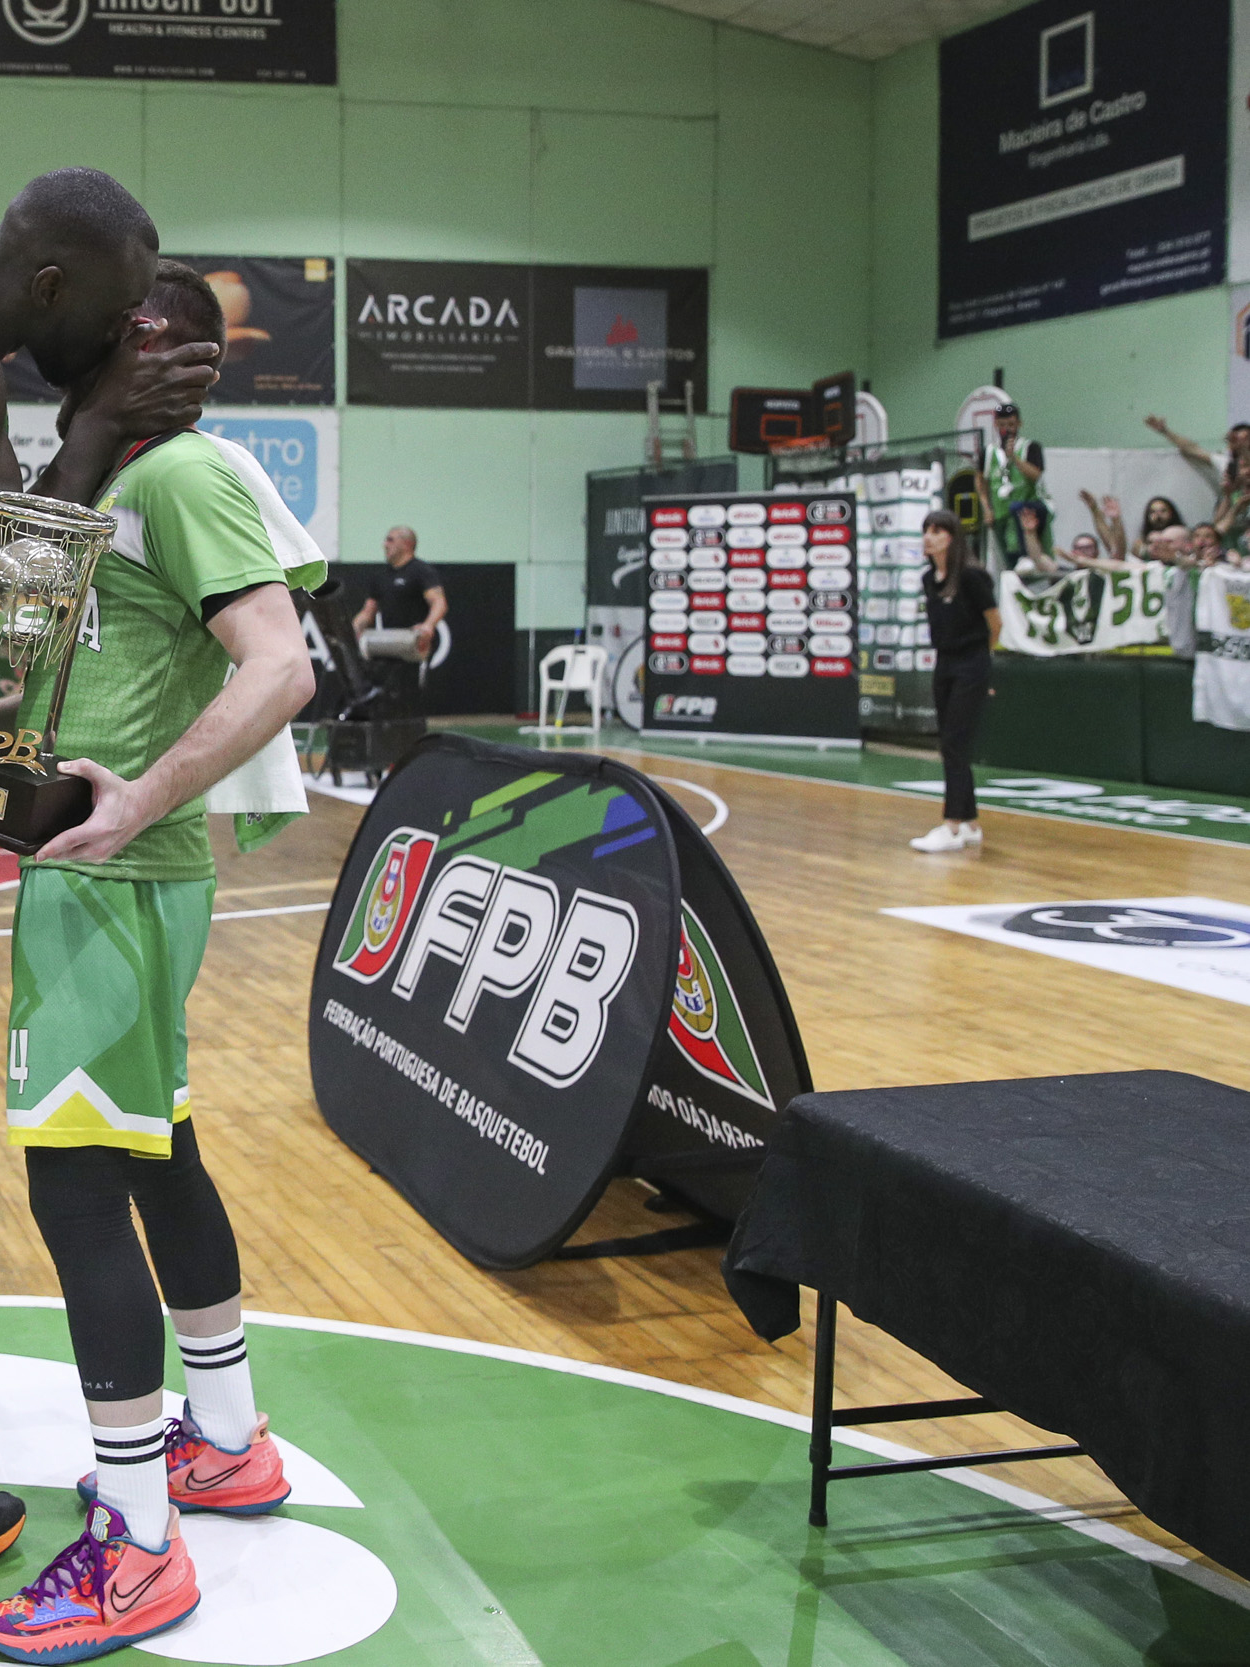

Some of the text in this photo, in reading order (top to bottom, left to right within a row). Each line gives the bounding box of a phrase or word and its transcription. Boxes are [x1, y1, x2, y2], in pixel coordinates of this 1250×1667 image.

[358, 293, 520, 328] ARCADA
[1111, 569, 1164, 626] 56
[672, 696, 718, 716] FPB
[391, 854, 640, 1089] FPB
[322, 998, 550, 1176] FEDERAÇÃO PORTUGUESA DE BASQUETEBOL
